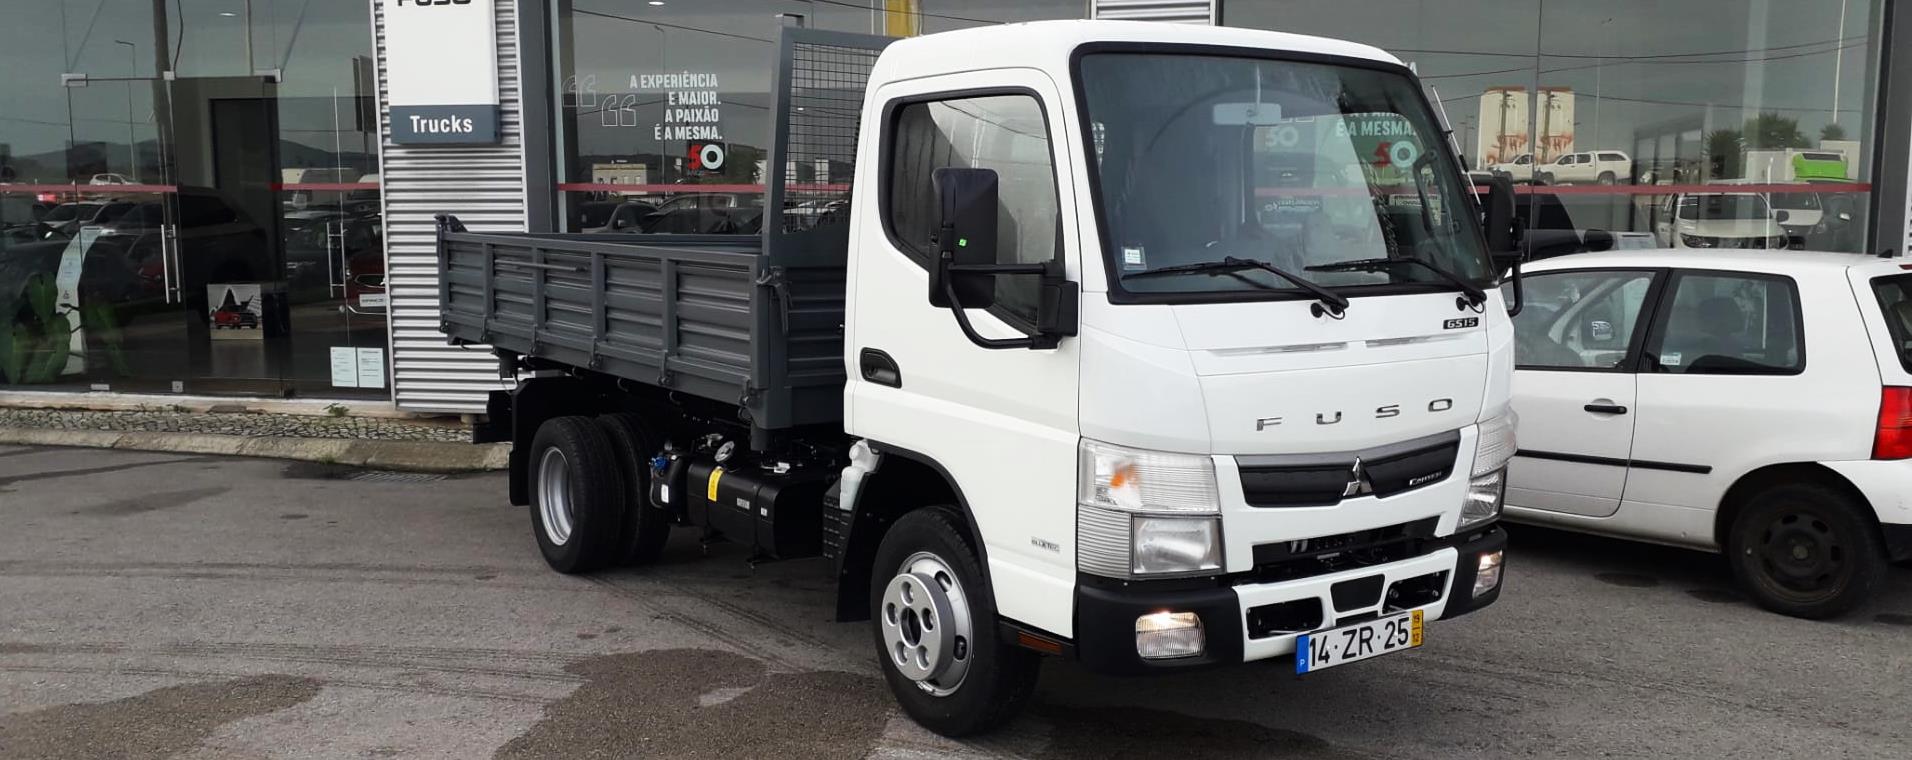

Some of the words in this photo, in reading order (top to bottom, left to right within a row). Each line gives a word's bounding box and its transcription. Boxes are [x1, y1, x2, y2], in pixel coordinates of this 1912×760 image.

[630, 75, 638, 88] A
[640, 70, 718, 88] EXPERIÊNCIA
[678, 91, 721, 105] MAIOR.
[665, 109, 673, 122] A
[676, 105, 719, 122] PAIXÃO
[409, 114, 473, 133] Trucks
[1348, 122, 1357, 136] A
[664, 127, 672, 140] A
[675, 126, 723, 140] MESMA.
[1256, 398, 1453, 431] FUSO
